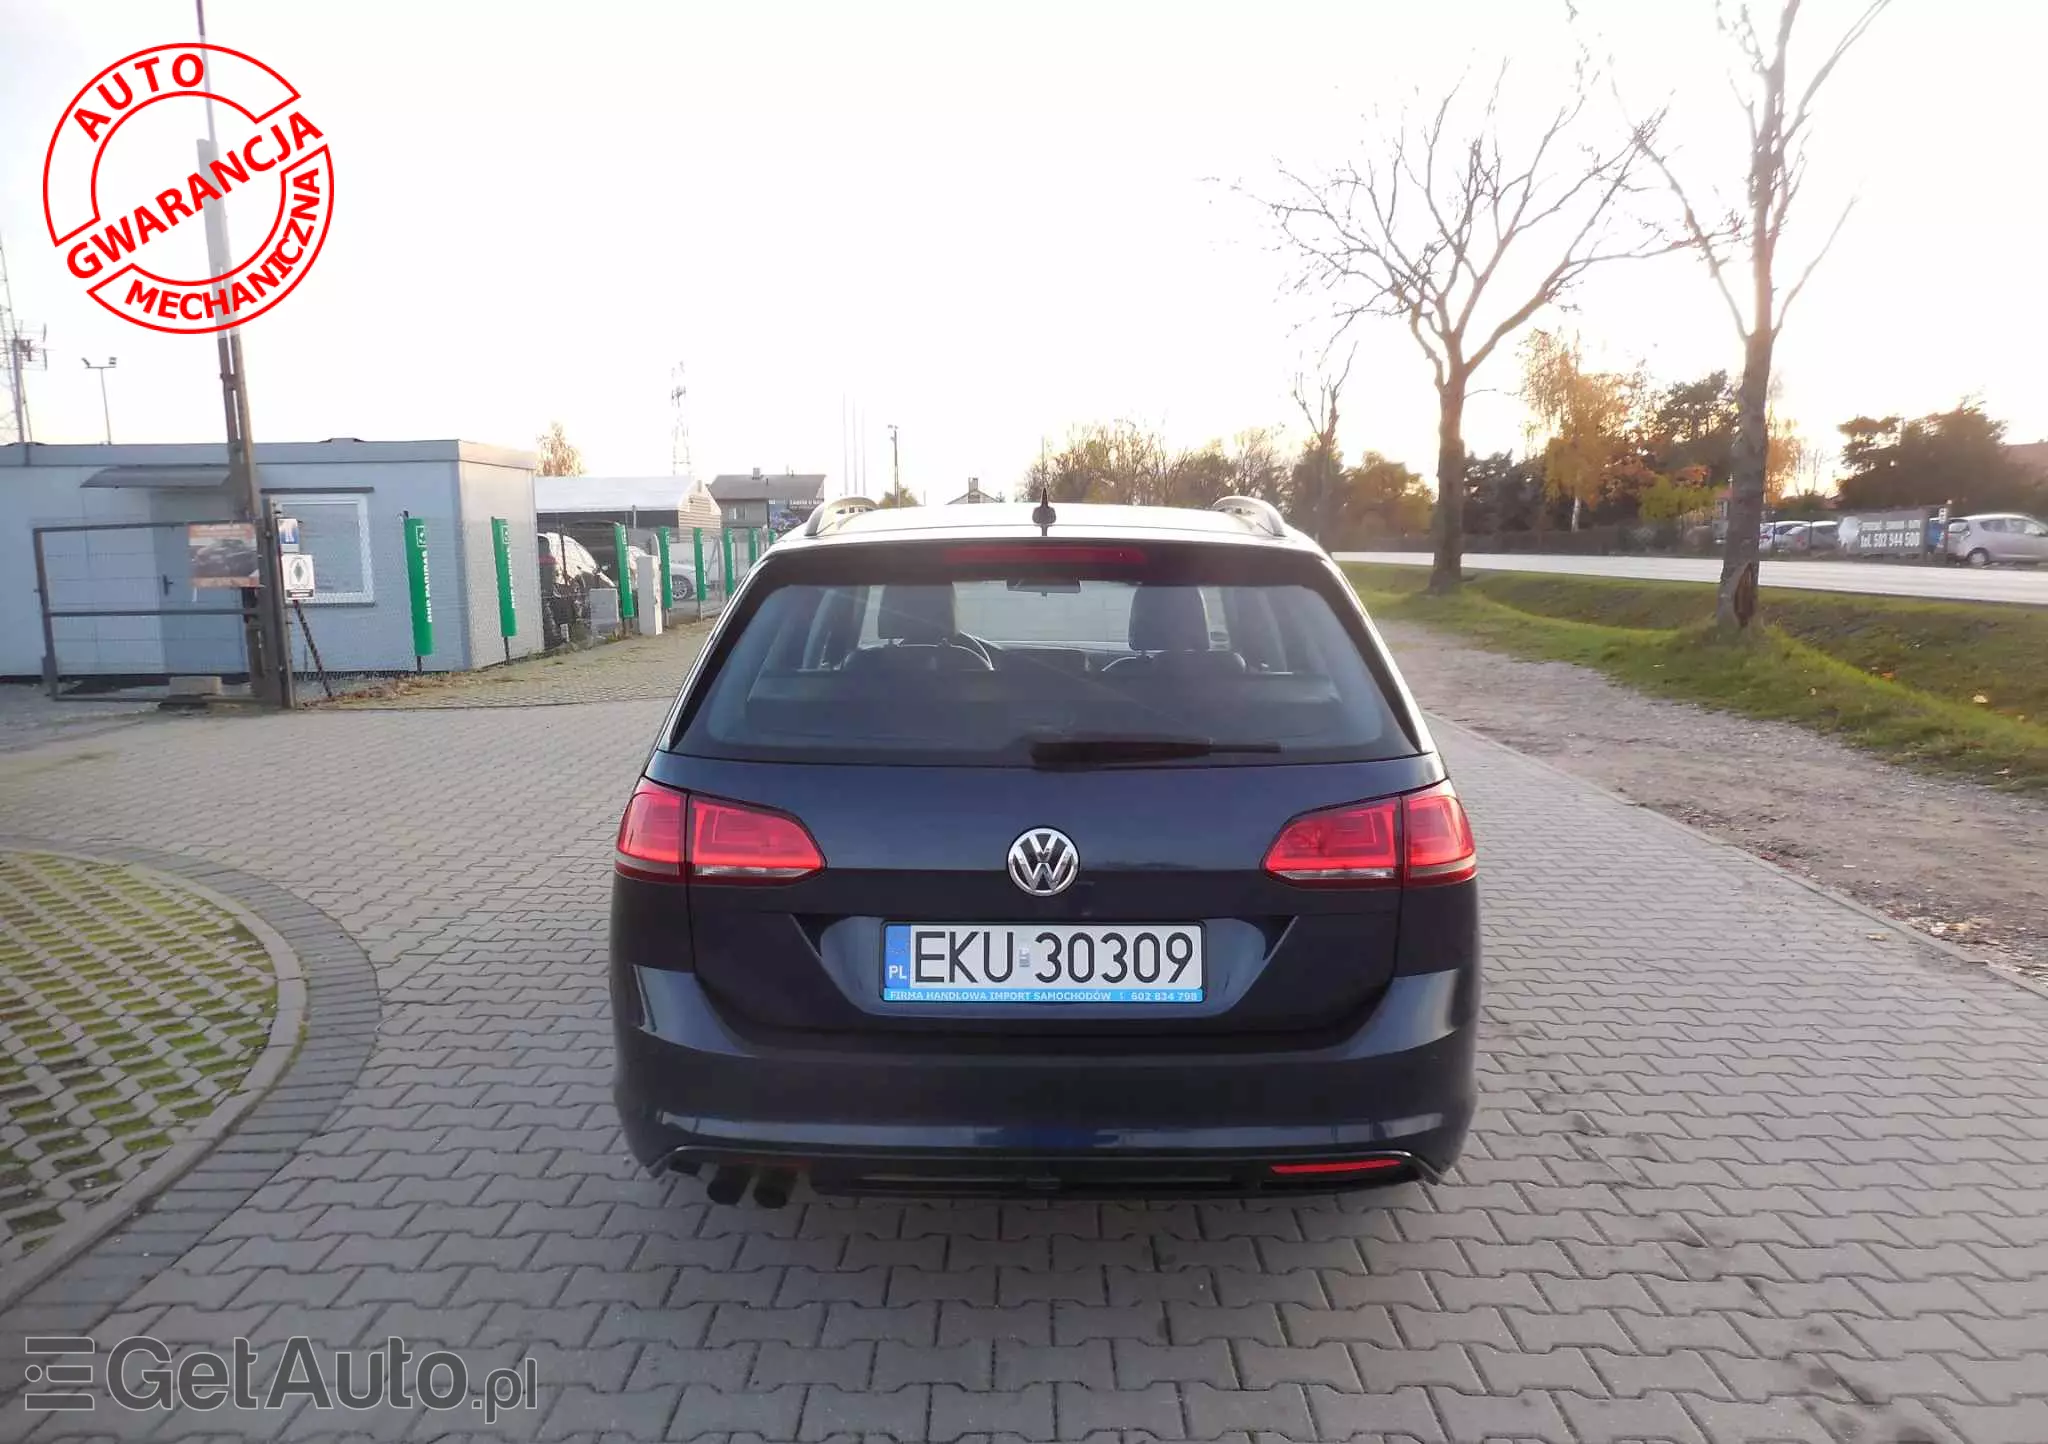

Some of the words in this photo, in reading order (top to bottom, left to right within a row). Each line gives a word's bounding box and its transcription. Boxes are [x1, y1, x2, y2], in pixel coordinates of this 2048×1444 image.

[915, 931, 1014, 983] EKU
[1034, 931, 1194, 983] 30309
[888, 965, 907, 980] PL
[890, 991, 924, 1000] FIRMA
[926, 991, 986, 1000] HANDLOWA
[989, 991, 1030, 1000] IMPORT
